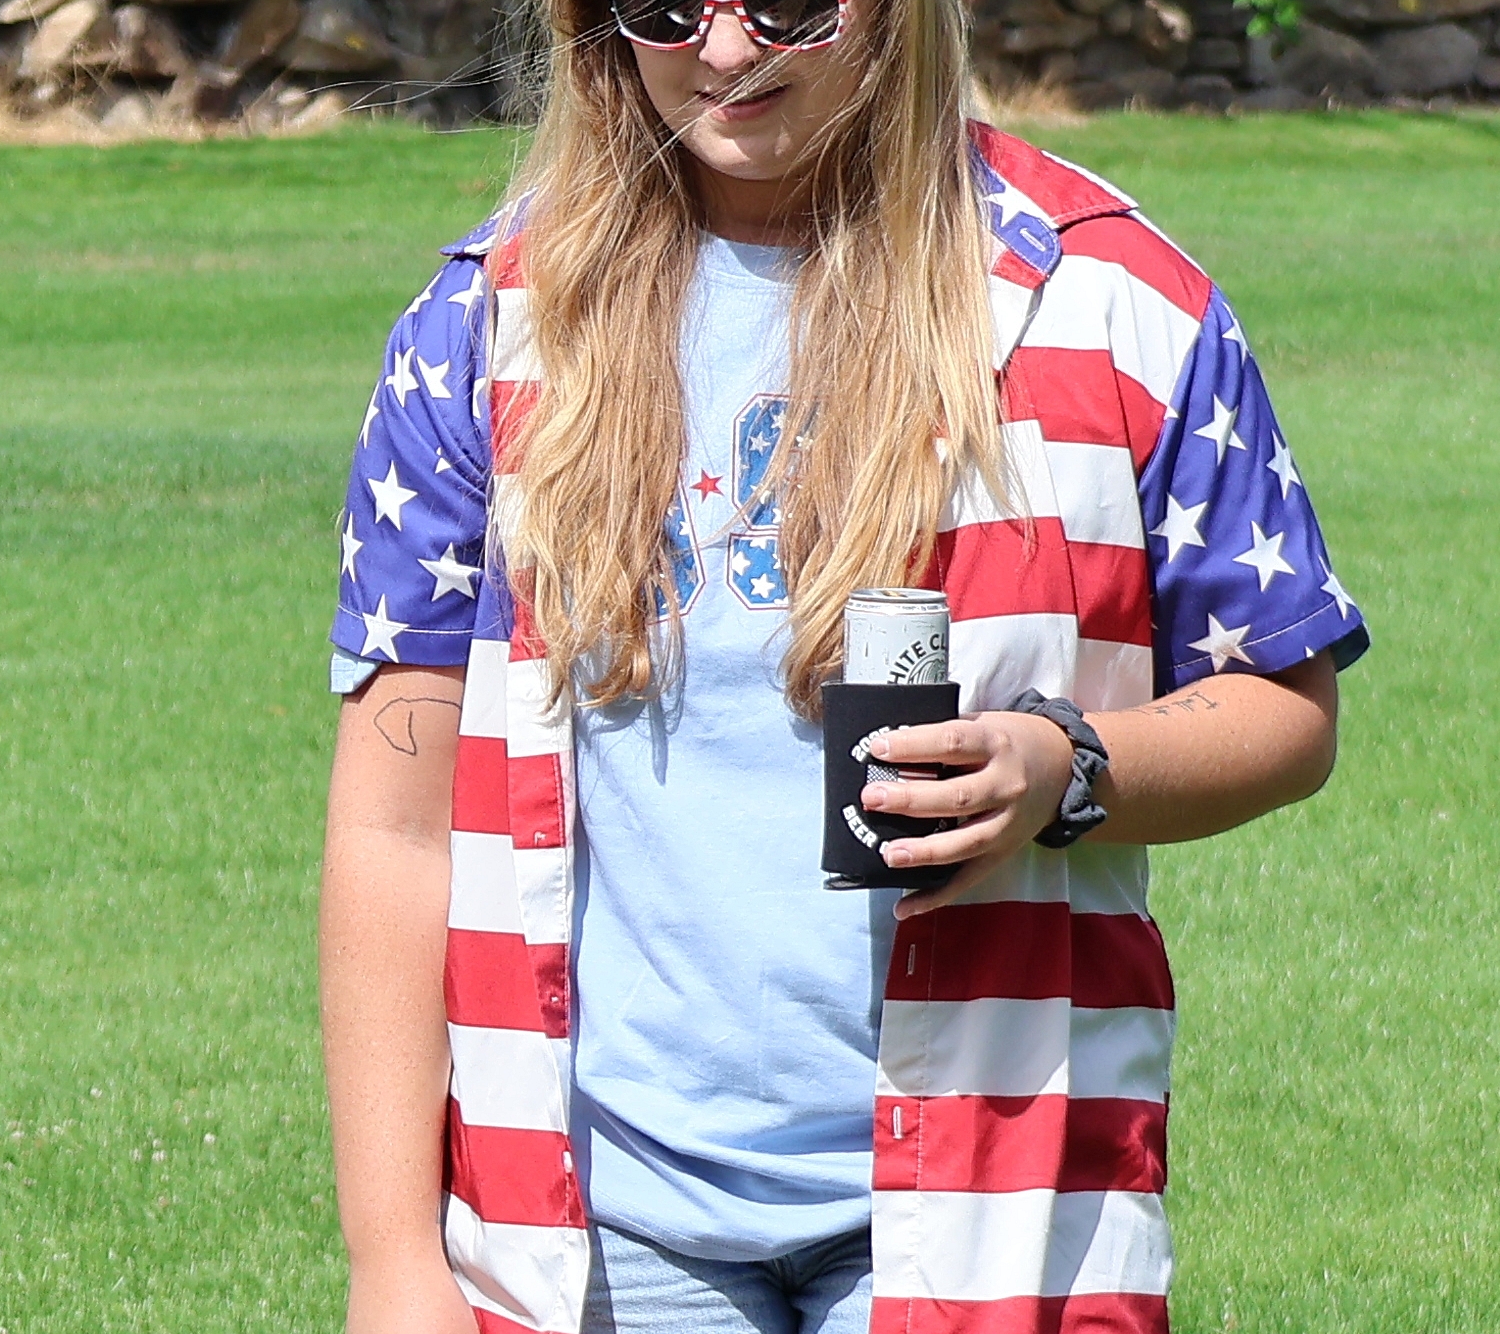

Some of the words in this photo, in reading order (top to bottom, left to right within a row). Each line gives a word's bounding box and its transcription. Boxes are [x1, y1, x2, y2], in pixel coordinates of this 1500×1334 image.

[886, 639, 927, 684] HITE
[929, 633, 947, 651] CL
[842, 804, 878, 848] BEER
